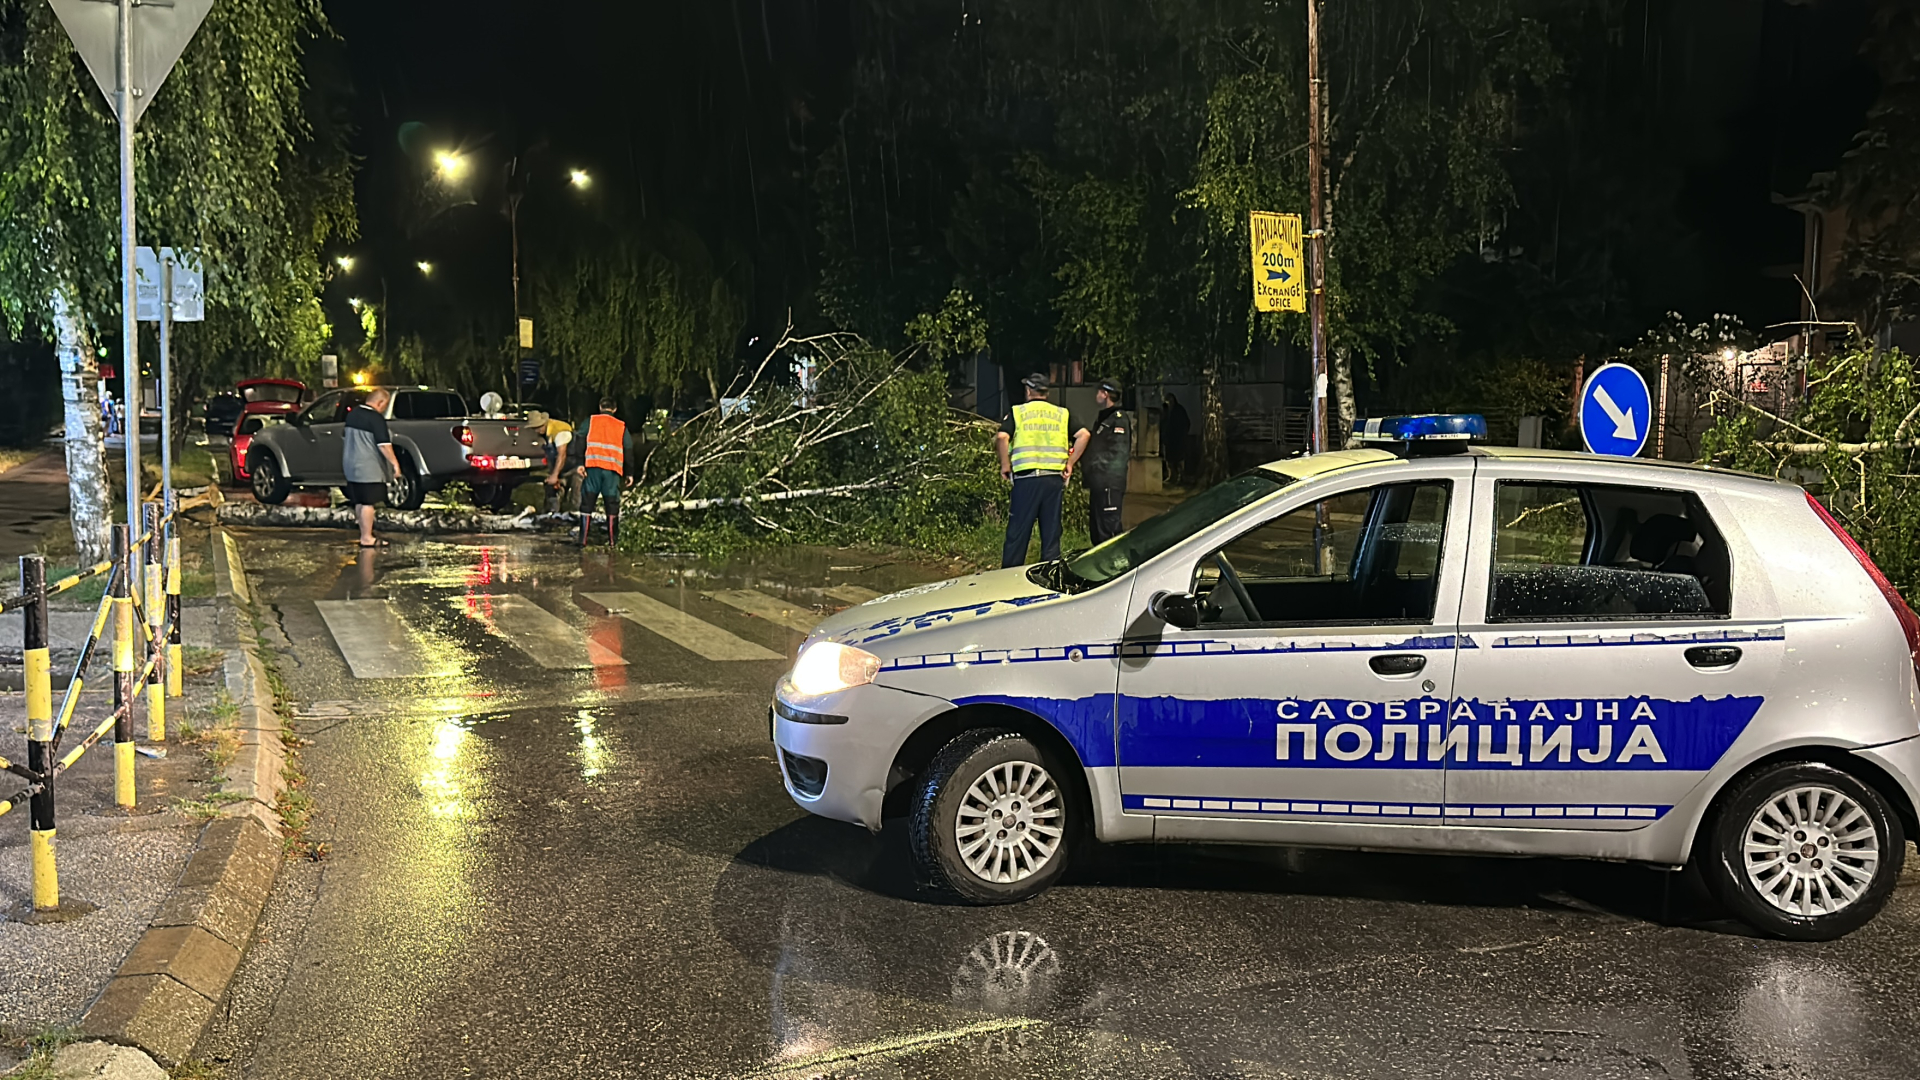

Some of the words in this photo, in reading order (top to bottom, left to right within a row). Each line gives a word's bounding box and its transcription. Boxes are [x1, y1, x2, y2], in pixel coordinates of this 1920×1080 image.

[1262, 252, 1294, 268] 200m
[1257, 281, 1300, 297] EXCHANGE
[1269, 298, 1291, 308] OFICE
[1276, 700, 1657, 721] САОБРАЋАЈНА
[1276, 723, 1668, 767] ПОЛИЦИЈА
